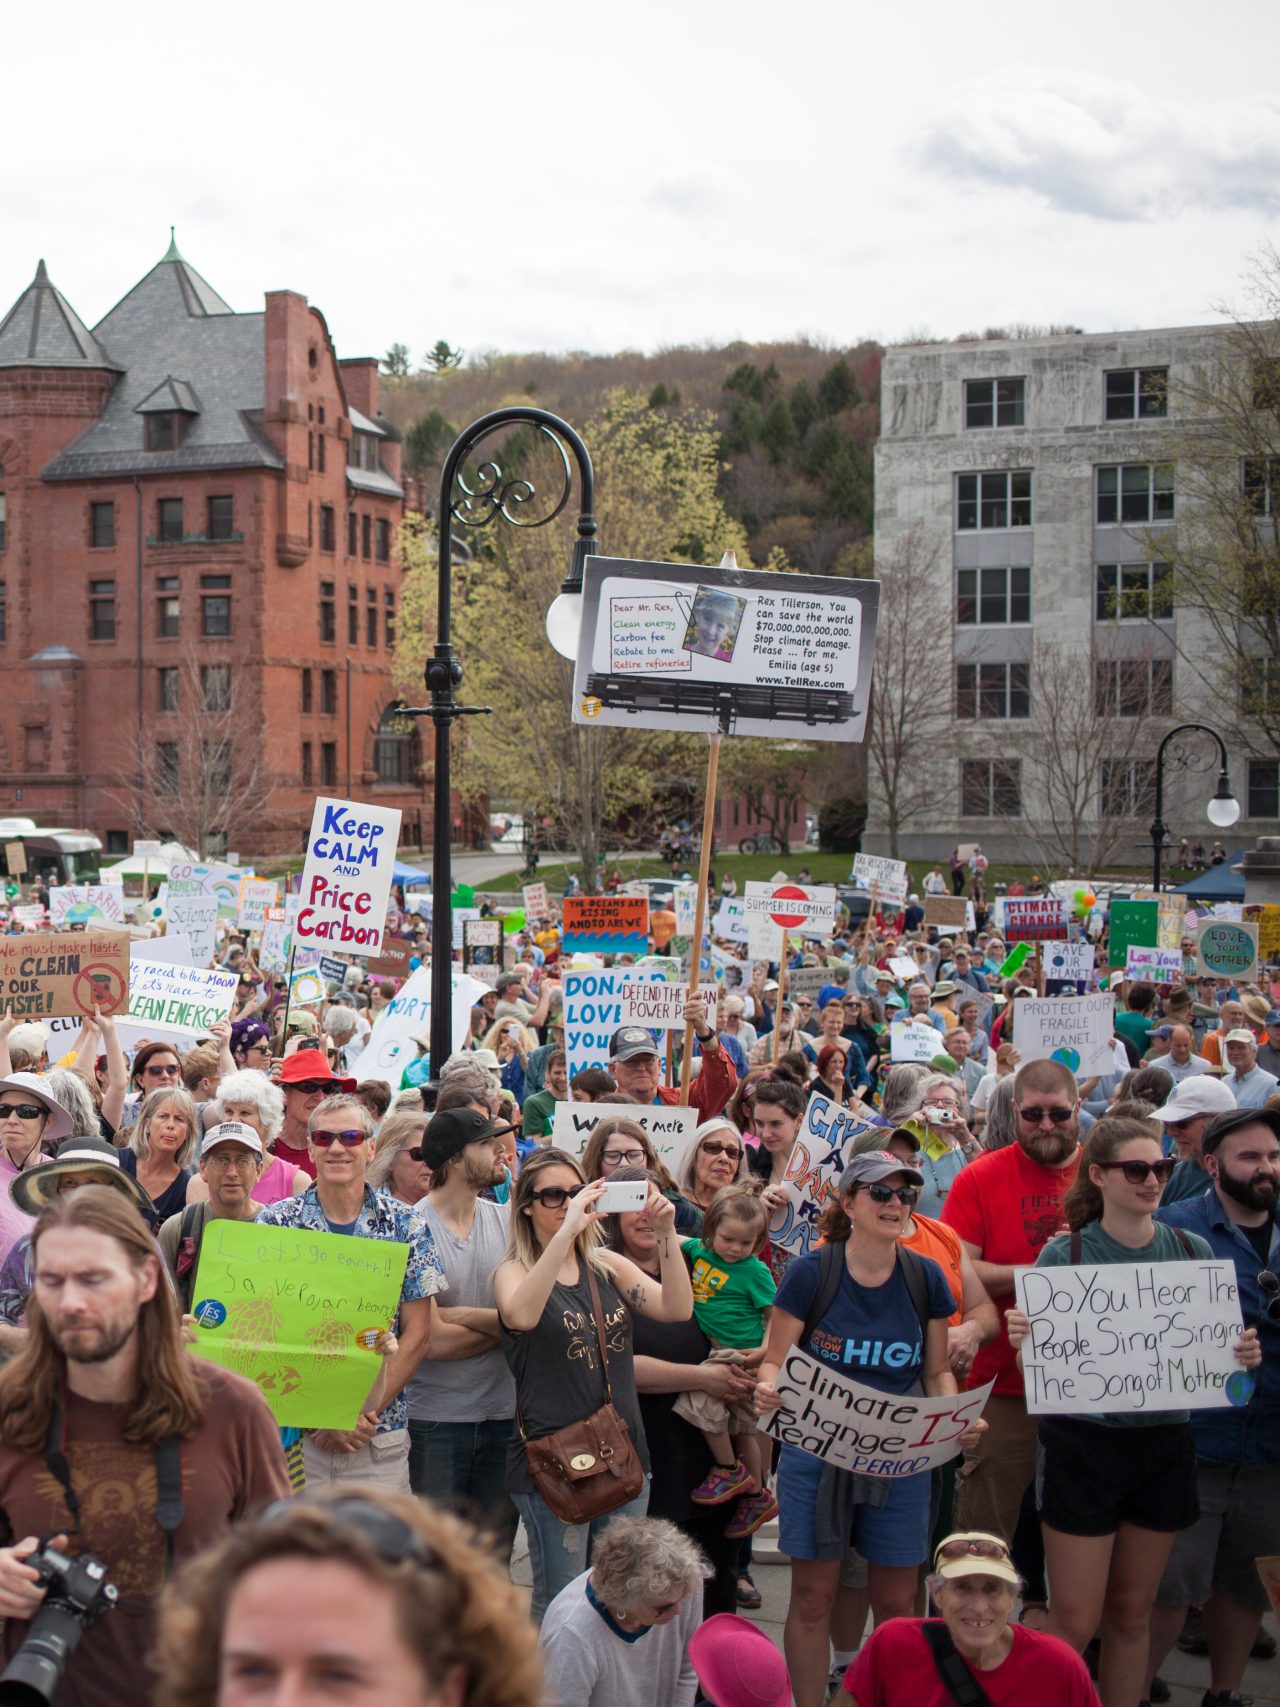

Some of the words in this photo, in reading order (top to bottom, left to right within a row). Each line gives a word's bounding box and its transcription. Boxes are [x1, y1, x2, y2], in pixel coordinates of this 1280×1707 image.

[613, 604, 635, 612] Dear
[654, 603, 674, 613] Rex,
[758, 596, 775, 606] Rex
[829, 602, 846, 612] You
[613, 620, 641, 629] Clean
[644, 621, 676, 631] energy
[806, 611, 823, 622] the
[827, 613, 854, 626] world
[613, 633, 647, 642] Carbon
[651, 633, 666, 642] fee
[754, 634, 774, 646] Stop
[778, 636, 811, 647] climate
[815, 639, 851, 650] damage.
[613, 648, 646, 656] Rebate
[648, 647, 658, 655] to
[753, 646, 782, 656] Please
[803, 649, 818, 658] for
[613, 660, 643, 669] Retire
[644, 659, 690, 669] refineries
[769, 660, 797, 671] Emilia
[801, 661, 821, 674] (age
[756, 676, 845, 689] www.TellRex.com
[322, 805, 385, 848] Keep
[313, 838, 379, 867] CALM
[170, 865, 192, 879] GO
[332, 864, 360, 876] AND
[309, 875, 372, 915] Price
[51, 889, 82, 918] SAVE
[87, 888, 122, 920] EARTH
[570, 900, 584, 908] THE
[589, 900, 625, 908] OCEANS
[746, 898, 784, 913] SUMMER
[786, 902, 796, 913] IS
[797, 903, 833, 916] COMING
[1008, 901, 1063, 914] CLIMATE
[168, 905, 216, 924] Science
[580, 908, 620, 917] RISING
[296, 908, 380, 947] Carbon
[607, 919, 624, 928] ARE
[625, 918, 642, 927] WE
[1010, 914, 1063, 927] CHANGE
[1007, 927, 1068, 942] MATTERS
[1211, 931, 1246, 943] LOVE
[21, 943, 54, 955] must
[58, 941, 87, 954] make
[1053, 944, 1085, 956] SAVE
[1216, 944, 1241, 952] YOUR
[3, 965, 16, 976] to
[19, 954, 80, 977] CLEAN
[322, 959, 345, 971] Planet
[1204, 953, 1251, 966] MOTHER
[144, 964, 176, 980] raced
[321, 967, 344, 979] Before
[1051, 967, 1091, 980] PLANET
[9, 978, 41, 993] OUR
[622, 984, 661, 1001] DEFEND
[663, 986, 683, 1003] THE
[629, 1003, 669, 1019] POWER
[1023, 1002, 1084, 1016] PROTECT
[1086, 997, 1111, 1012] OUR
[169, 998, 228, 1030] ENERGY
[1040, 1017, 1089, 1030] FRAGILE
[1042, 1032, 1091, 1047] PLANET
[309, 1245, 328, 1265] go
[1022, 1272, 1073, 1318] Do
[1074, 1271, 1129, 1314] You
[1136, 1267, 1197, 1309] Hear
[1198, 1266, 1237, 1304] The
[821, 1341, 842, 1351] LOW
[1030, 1318, 1092, 1365] People
[821, 1349, 840, 1361] GO
[1025, 1364, 1076, 1405] The
[1078, 1360, 1146, 1408] Song
[1146, 1361, 1163, 1391] of
[1167, 1357, 1230, 1394] Mother
[785, 1356, 919, 1424] Climate
[907, 1399, 982, 1449] IS
[765, 1407, 836, 1459] Real
[852, 1455, 931, 1475] PERIOD
